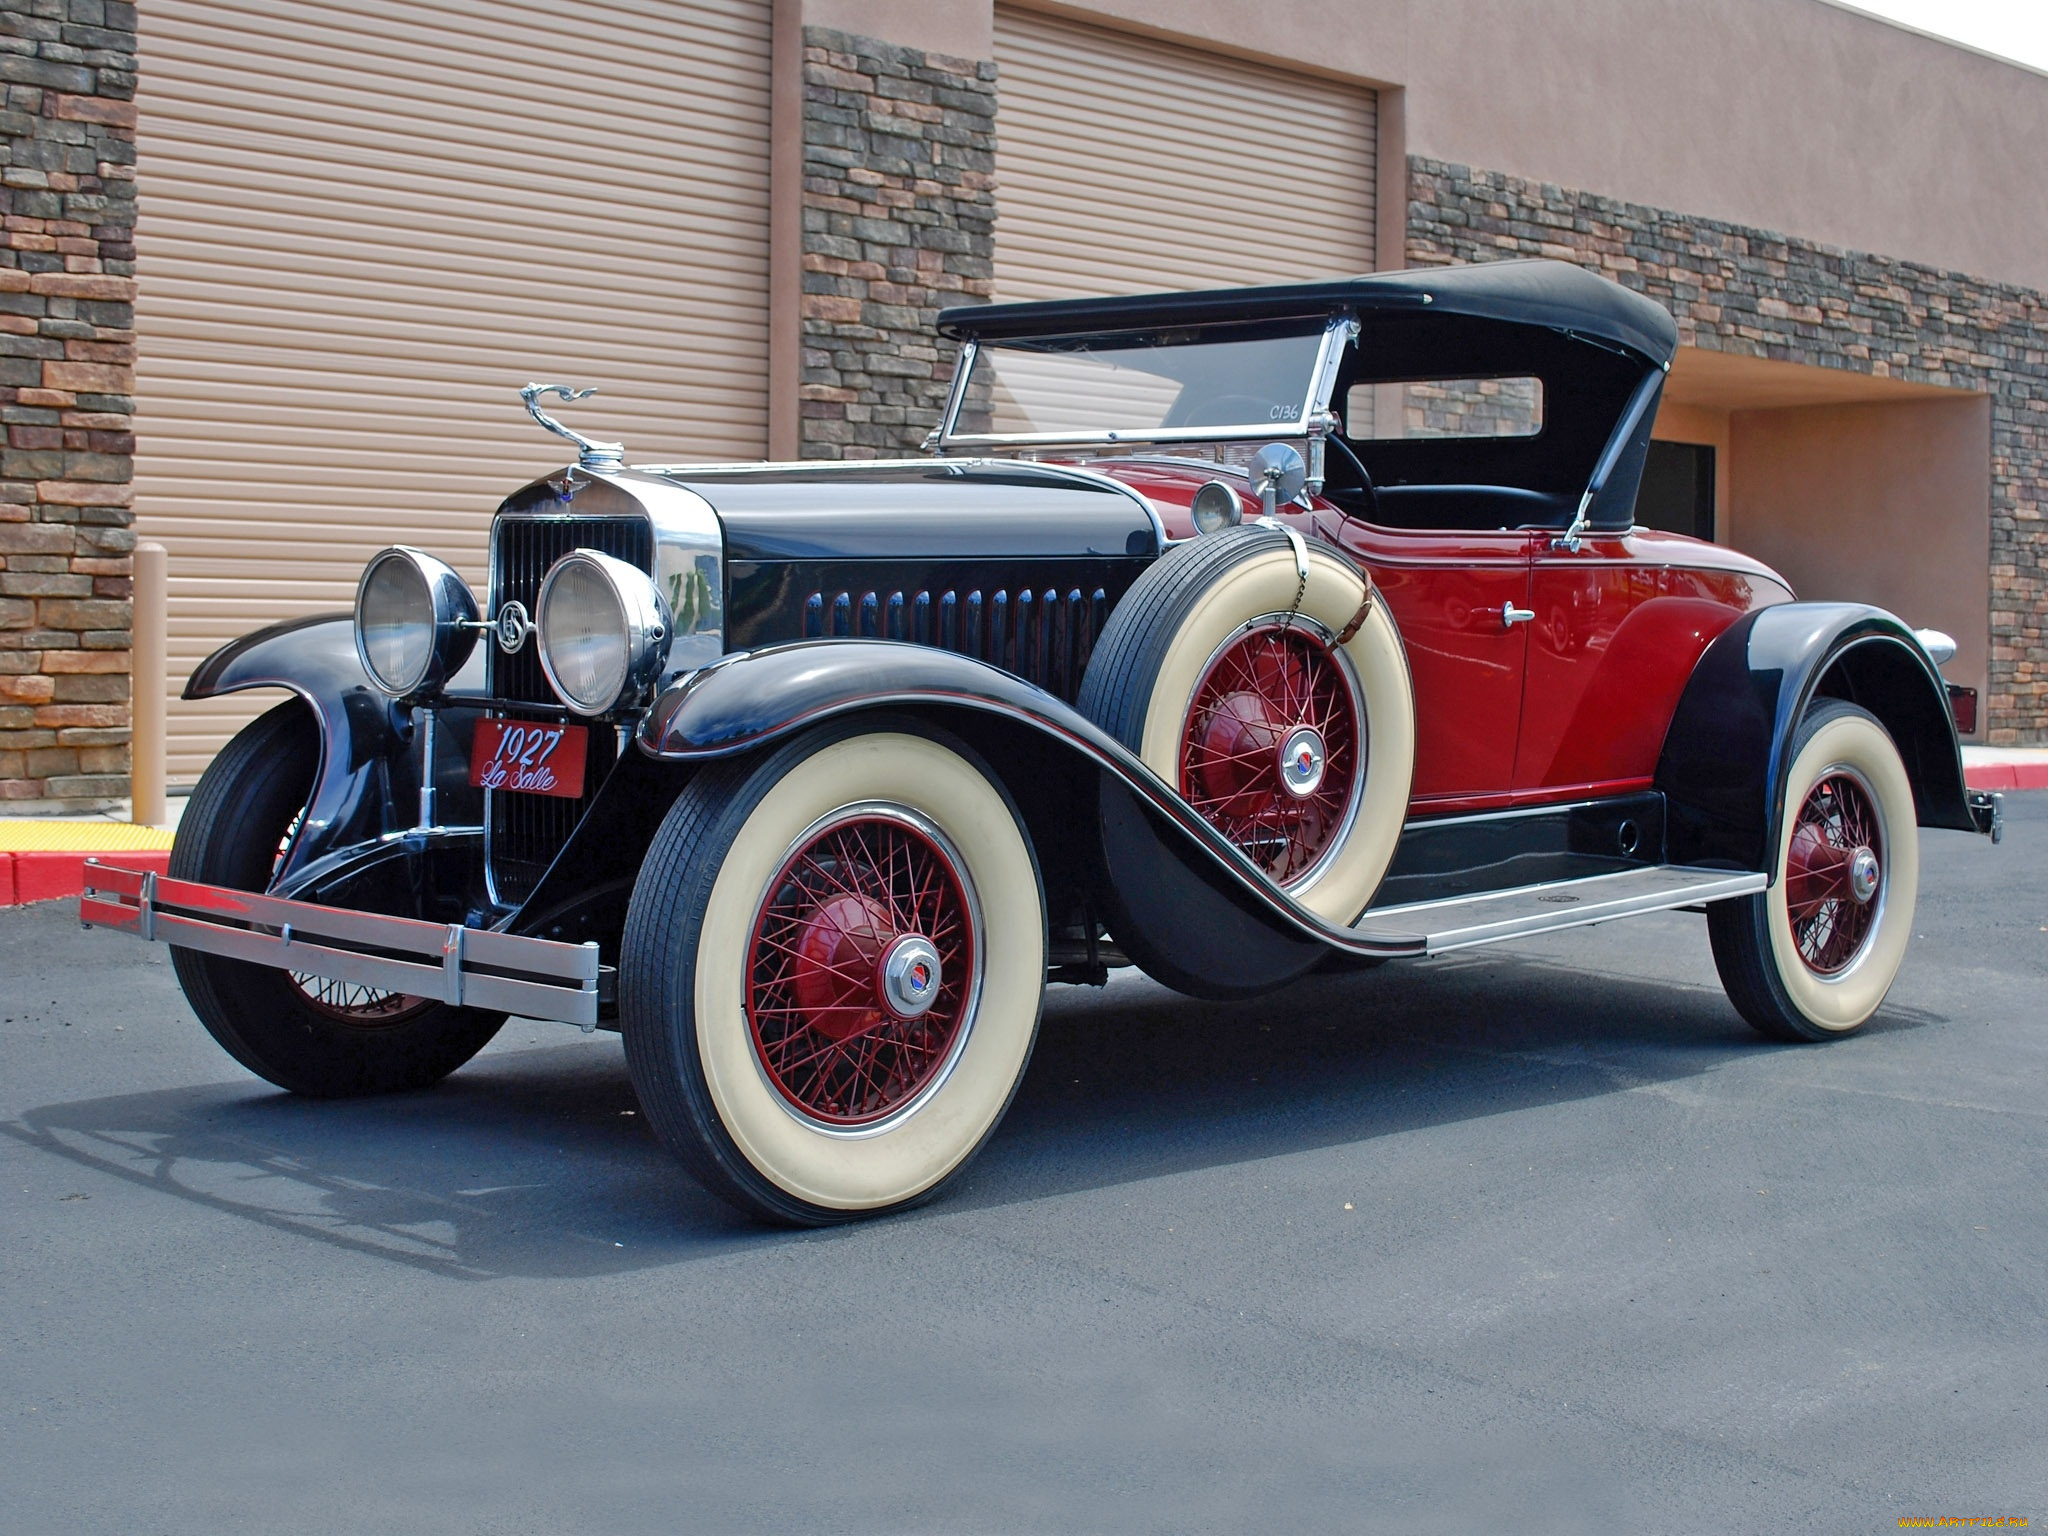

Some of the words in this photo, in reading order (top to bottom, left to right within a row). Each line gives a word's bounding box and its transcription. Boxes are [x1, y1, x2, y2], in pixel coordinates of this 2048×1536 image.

[1270, 404, 1298, 420] C136
[494, 725, 561, 766] 1927
[480, 760, 509, 789] La
[509, 764, 558, 792] Salle
